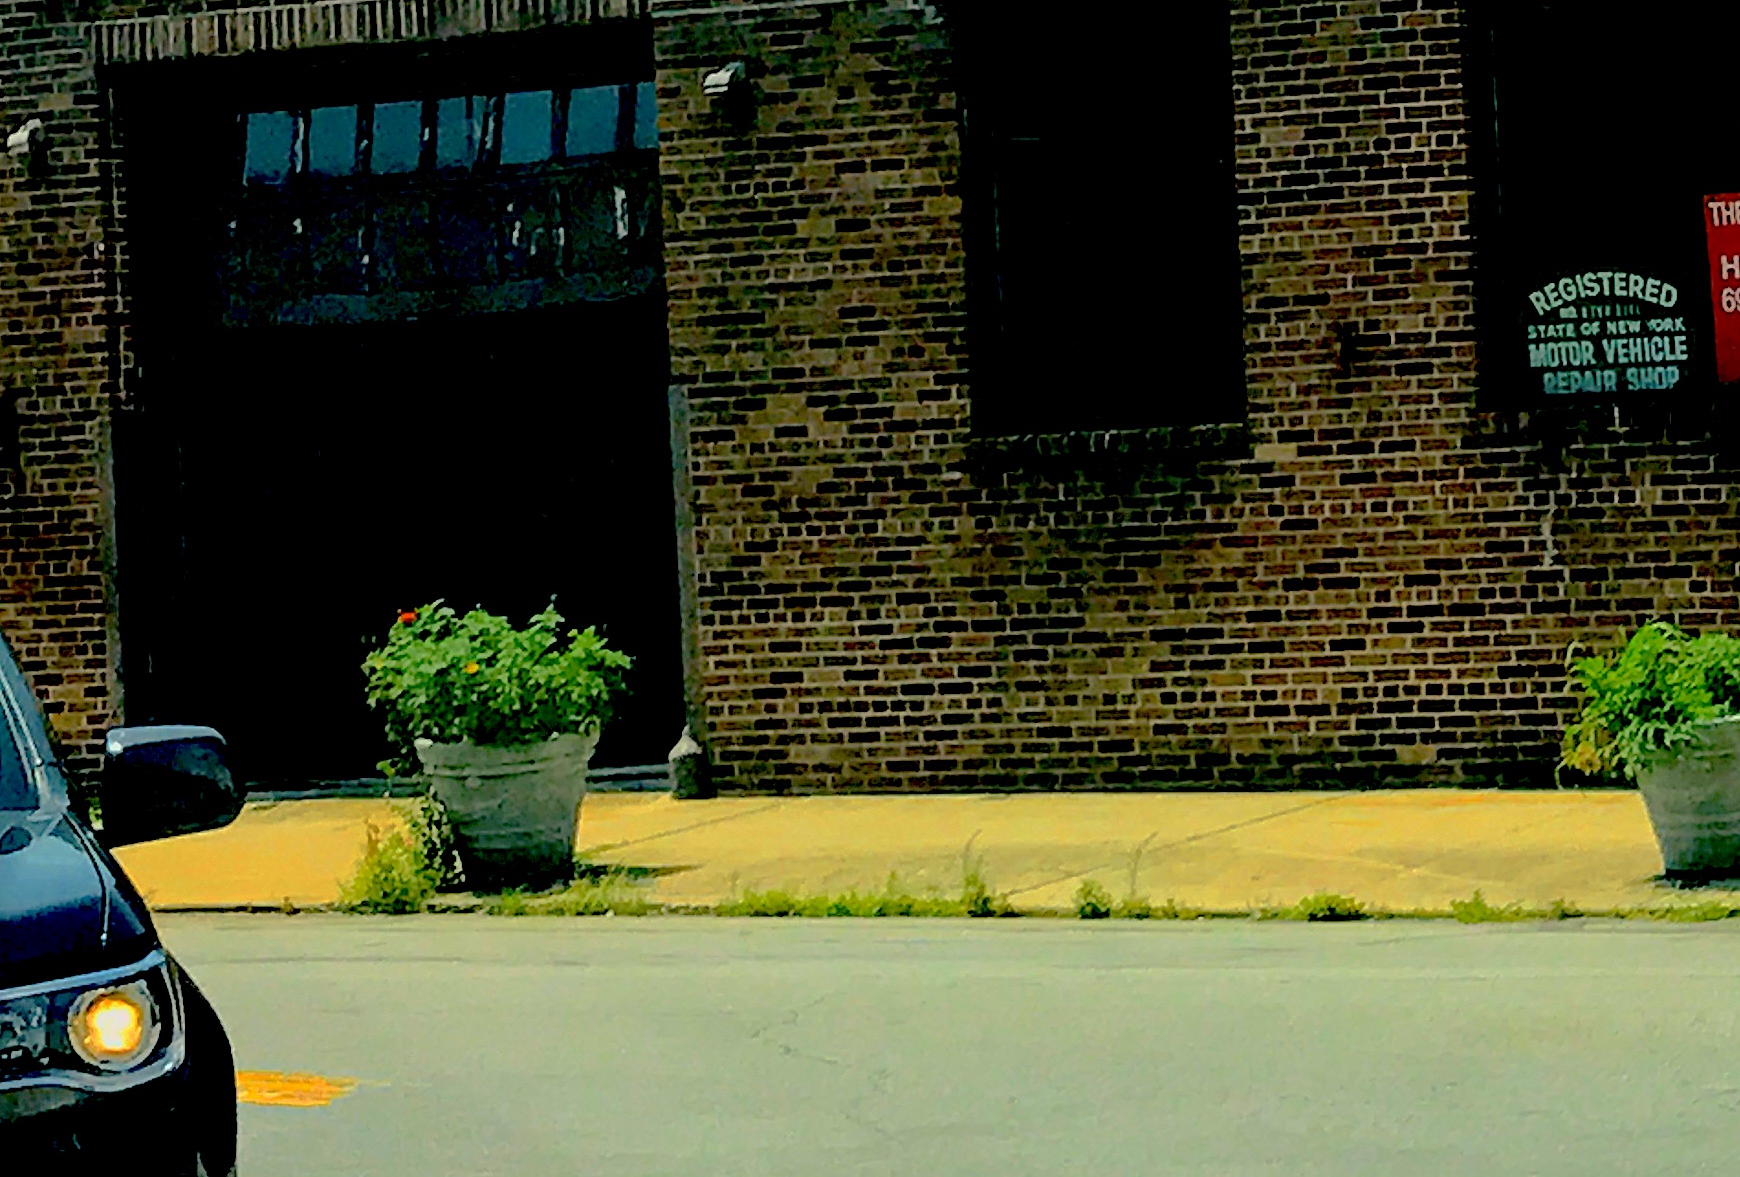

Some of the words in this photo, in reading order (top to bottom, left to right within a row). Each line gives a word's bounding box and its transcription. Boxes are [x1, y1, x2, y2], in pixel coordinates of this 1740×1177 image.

[1527, 271, 1678, 316] REGISTERED
[1527, 322, 1577, 340] STATE
[1579, 320, 1601, 336] OF
[1606, 319, 1642, 335] NEW
[1645, 316, 1687, 333] YORK
[1527, 340, 1597, 368] MOTOR
[1601, 335, 1689, 364] VEHICLE
[1543, 368, 1617, 394] REPAIR
[1625, 365, 1680, 391] SHOP
